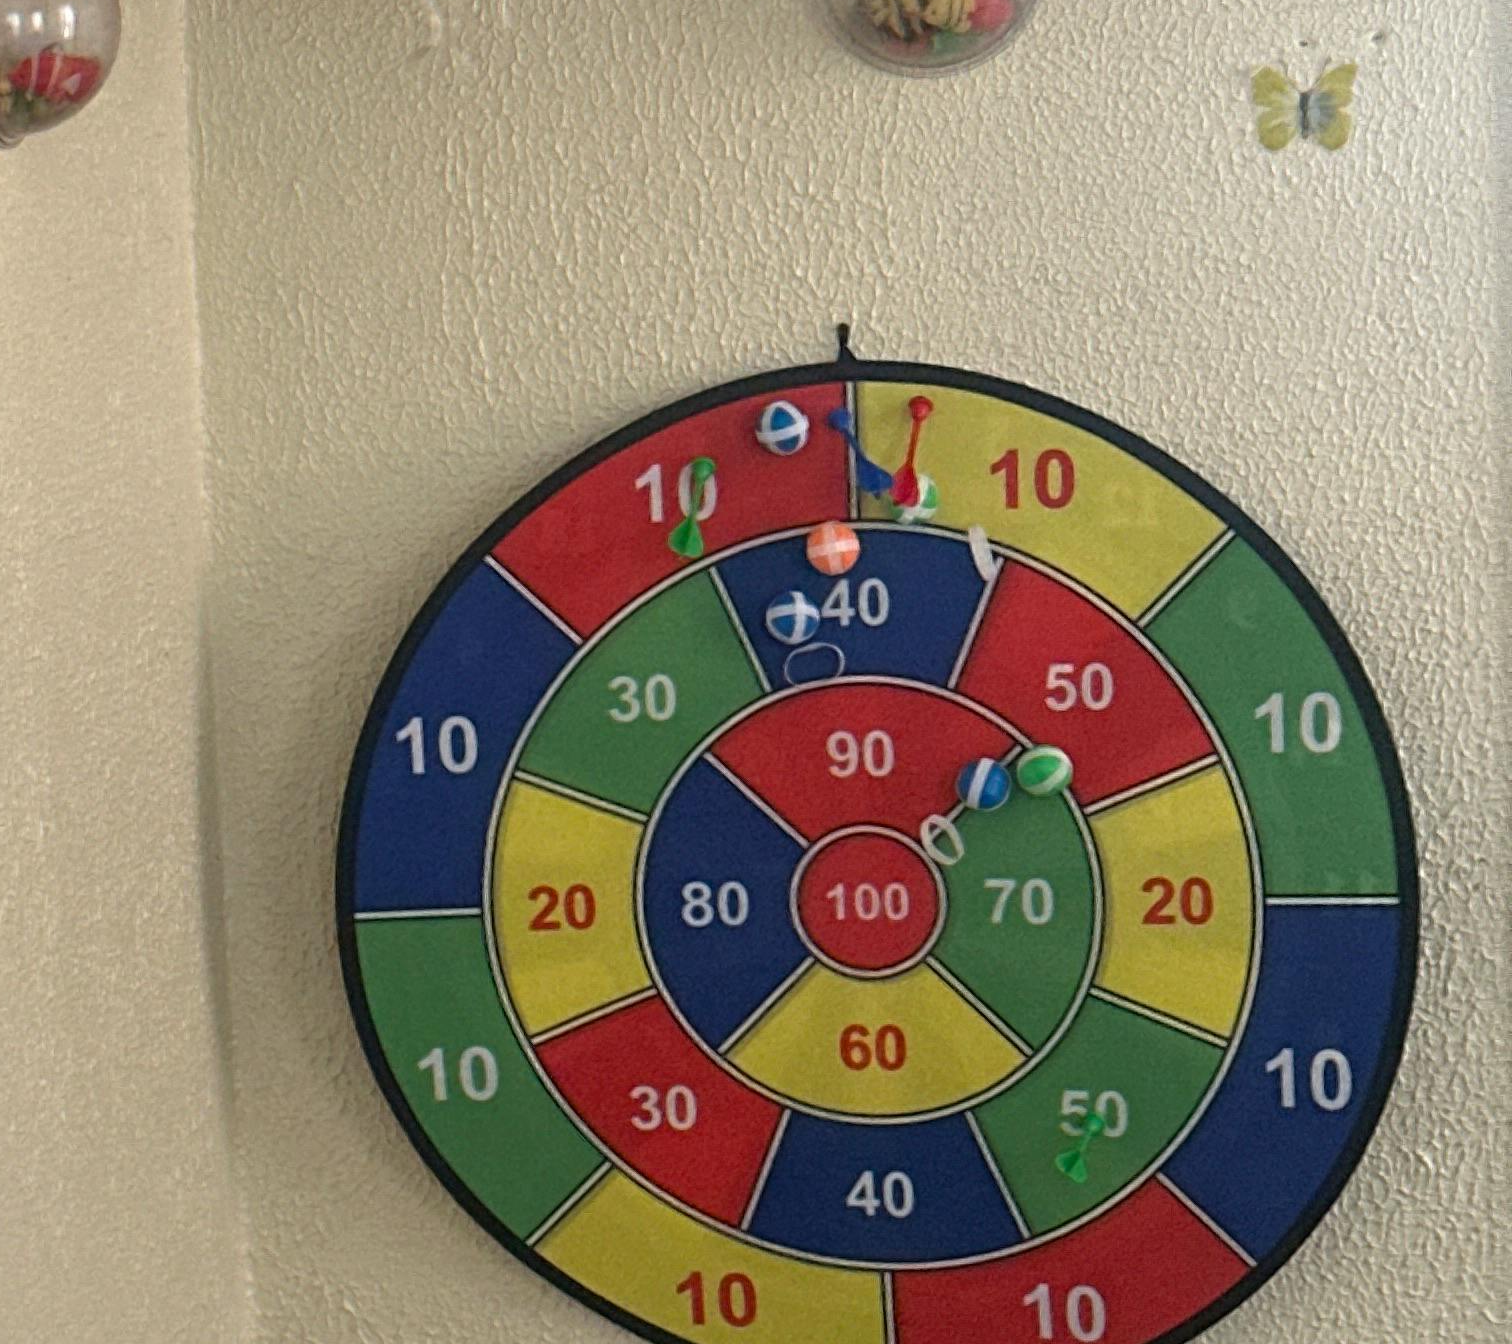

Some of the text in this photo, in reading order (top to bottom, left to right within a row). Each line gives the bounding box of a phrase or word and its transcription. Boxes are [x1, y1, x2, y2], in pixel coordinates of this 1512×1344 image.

[635, 462, 718, 523] 10
[989, 448, 1076, 509] 10
[821, 577, 890, 627] 40
[607, 674, 676, 722] 30
[1044, 662, 1115, 711] 50
[395, 716, 479, 775] 10
[1254, 692, 1342, 754] 10
[826, 730, 895, 778] 90
[527, 884, 597, 931] 20
[681, 881, 750, 927] 80
[826, 882, 910, 921] 100
[984, 878, 1054, 925] 70
[1141, 877, 1215, 925] 20
[839, 1024, 907, 1071] 60
[417, 1047, 500, 1102] 10
[1265, 1048, 1353, 1111] 10
[629, 1085, 698, 1131] 30
[1060, 1090, 1129, 1139] 50
[846, 1171, 915, 1218] 40
[675, 1271, 758, 1328] 10
[1022, 1283, 1106, 1343] 10
